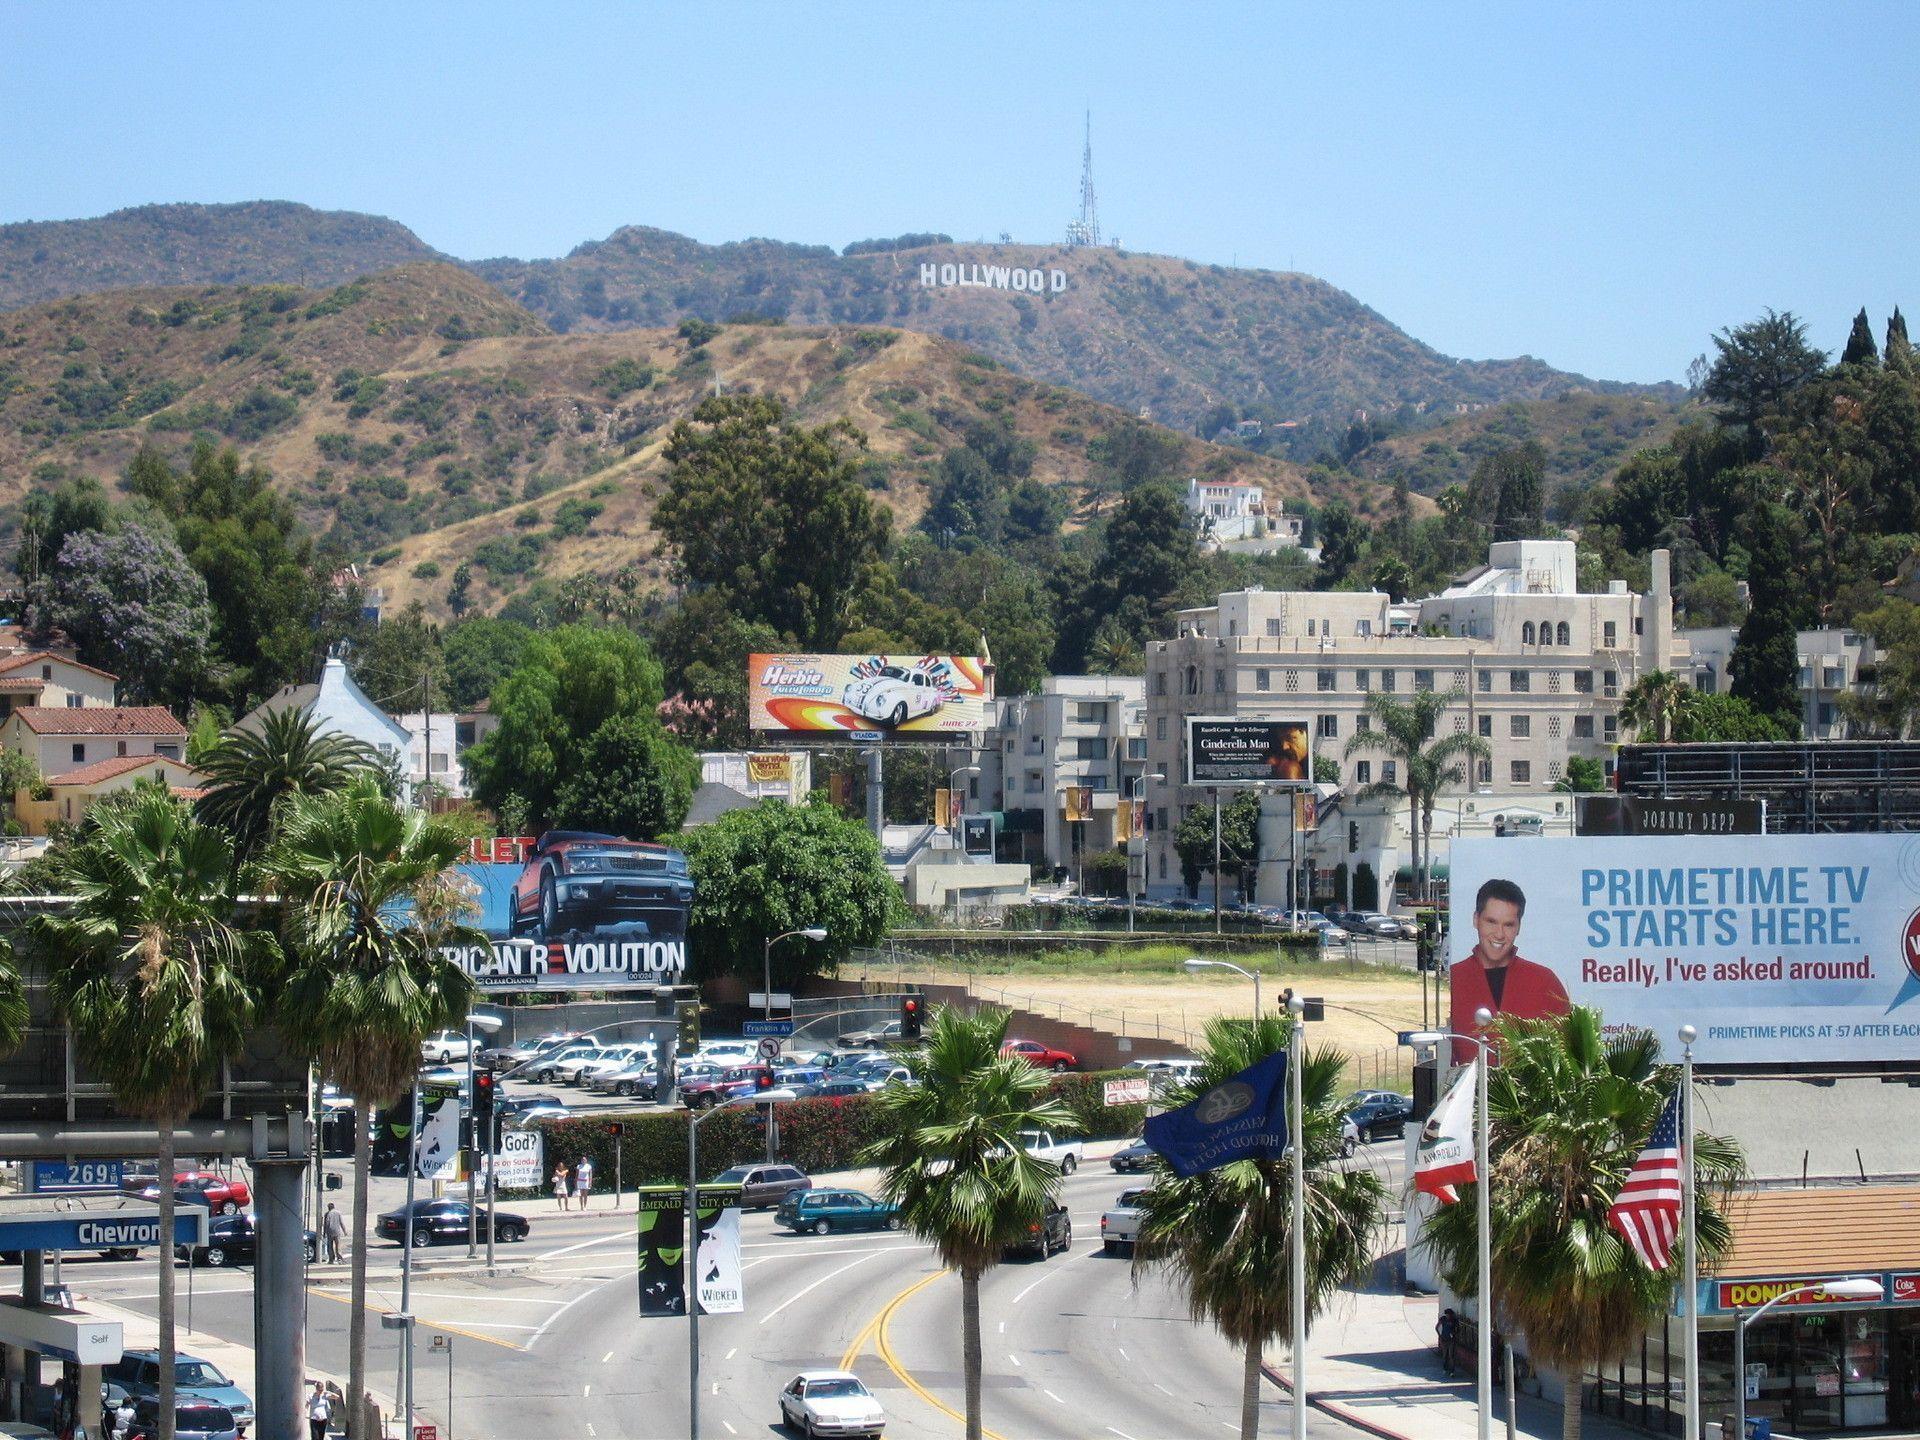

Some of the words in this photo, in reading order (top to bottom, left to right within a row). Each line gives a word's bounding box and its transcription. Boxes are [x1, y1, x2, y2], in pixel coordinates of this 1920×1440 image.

[920, 263, 1067, 293] HOLLYWOOD
[761, 665, 822, 686] Herbie
[1201, 739, 1247, 749] Cinderella
[1249, 739, 1270, 749] Man
[1643, 811, 1693, 830] JOHNNY
[1703, 813, 1735, 831] DEPP
[469, 837, 536, 863] LET
[1582, 867, 1809, 906] PRIMETIME
[1819, 866, 1870, 904] TV
[1587, 908, 1738, 948] STARTS
[1752, 907, 1860, 945] HERE.
[531, 942, 685, 975] REVOLUTION
[1582, 957, 1659, 988] Really,
[1666, 957, 1706, 981] I've
[1713, 956, 1782, 981] asked
[1790, 955, 1875, 980] around.
[1602, 1023, 1624, 1034] sted
[1709, 1026, 1777, 1039] PRIMETIME
[1780, 1025, 1815, 1038] PICKS
[1818, 1025, 1832, 1038] AT
[1836, 1025, 1850, 1038] :57
[1853, 1025, 1890, 1037] AFTER
[505, 1134, 537, 1151] God?
[68, 1164, 107, 1183] 269
[640, 1200, 681, 1210] EMERALD
[722, 1198, 735, 1206] CA
[79, 1223, 160, 1244] Chevron
[1731, 1283, 1806, 1304] DONUT
[1896, 1279, 1914, 1290] Coke
[1805, 1317, 1825, 1326] ATM
[91, 1335, 110, 1344] Self
